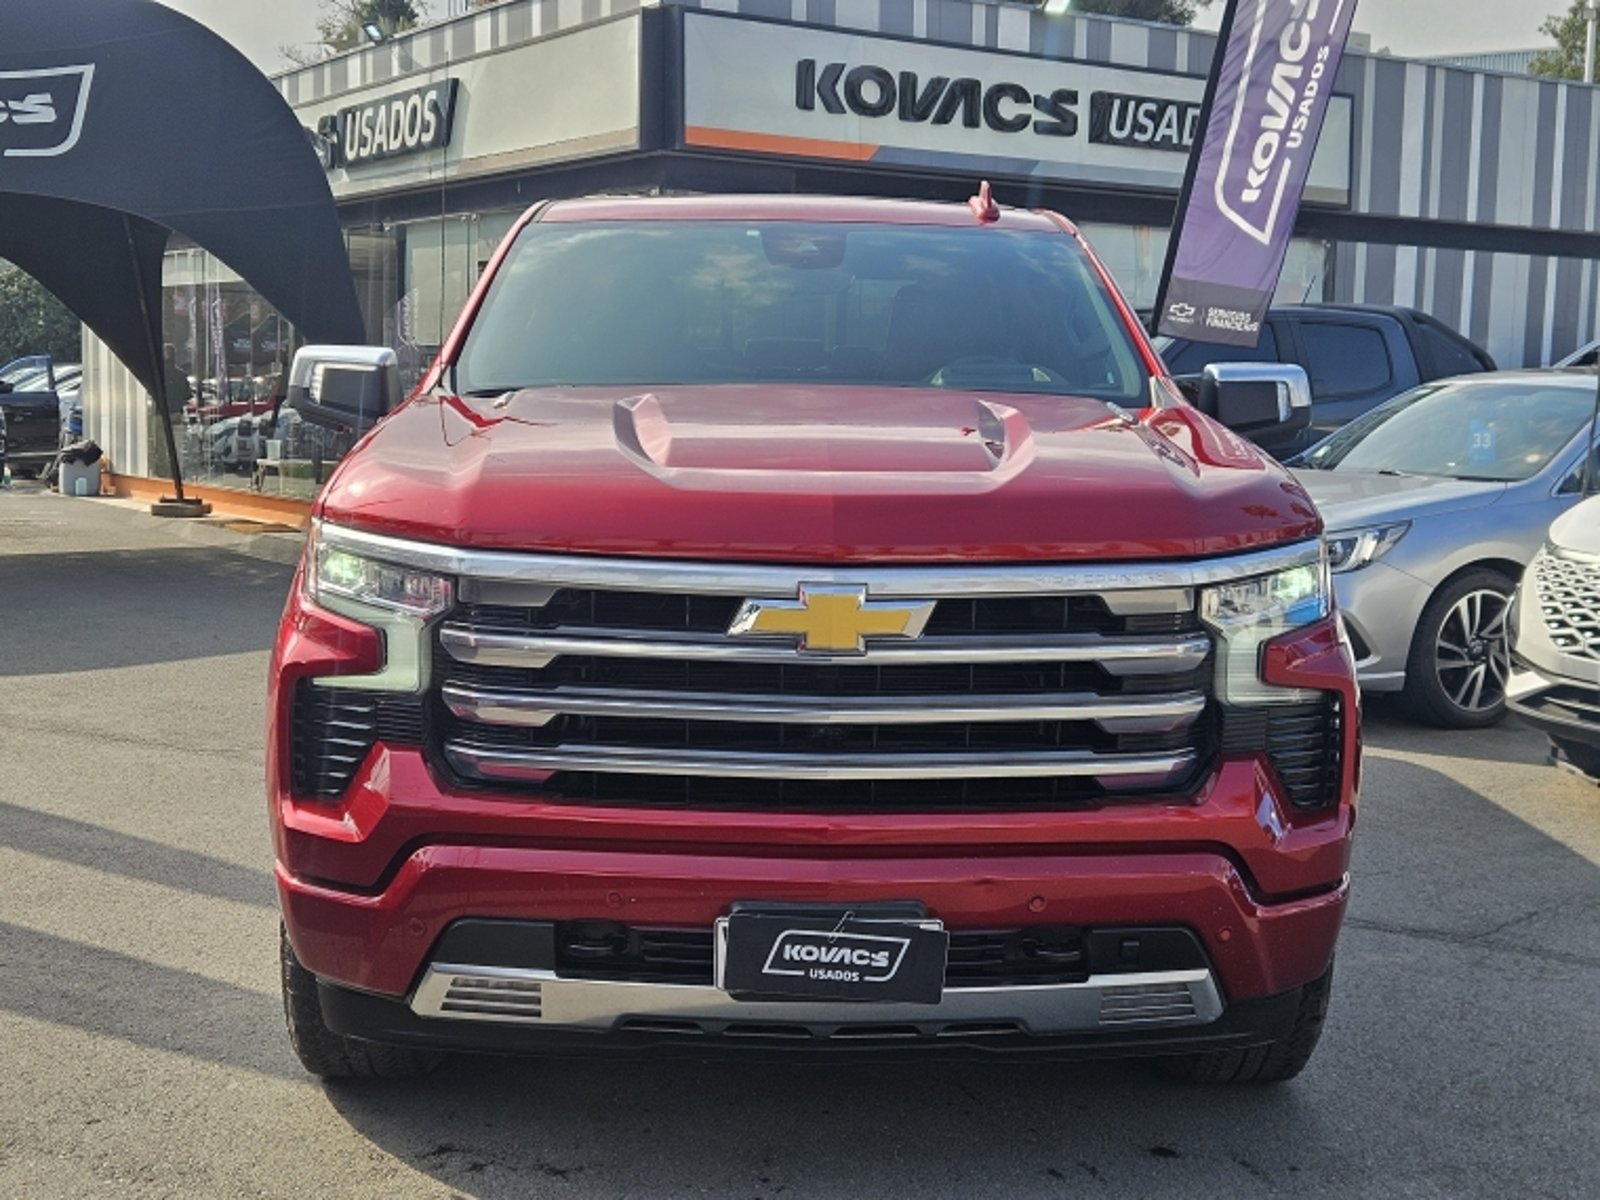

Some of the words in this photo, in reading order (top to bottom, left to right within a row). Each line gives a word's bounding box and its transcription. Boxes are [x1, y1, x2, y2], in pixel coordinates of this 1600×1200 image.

[0, 92, 58, 125] S
[796, 58, 1079, 137] KOVACS
[1285, 45, 1329, 148] USADOS
[344, 90, 438, 161] USADOS
[1472, 432, 1492, 449] 33
[783, 944, 890, 968] KOVACS
[809, 968, 861, 982] USADOS
